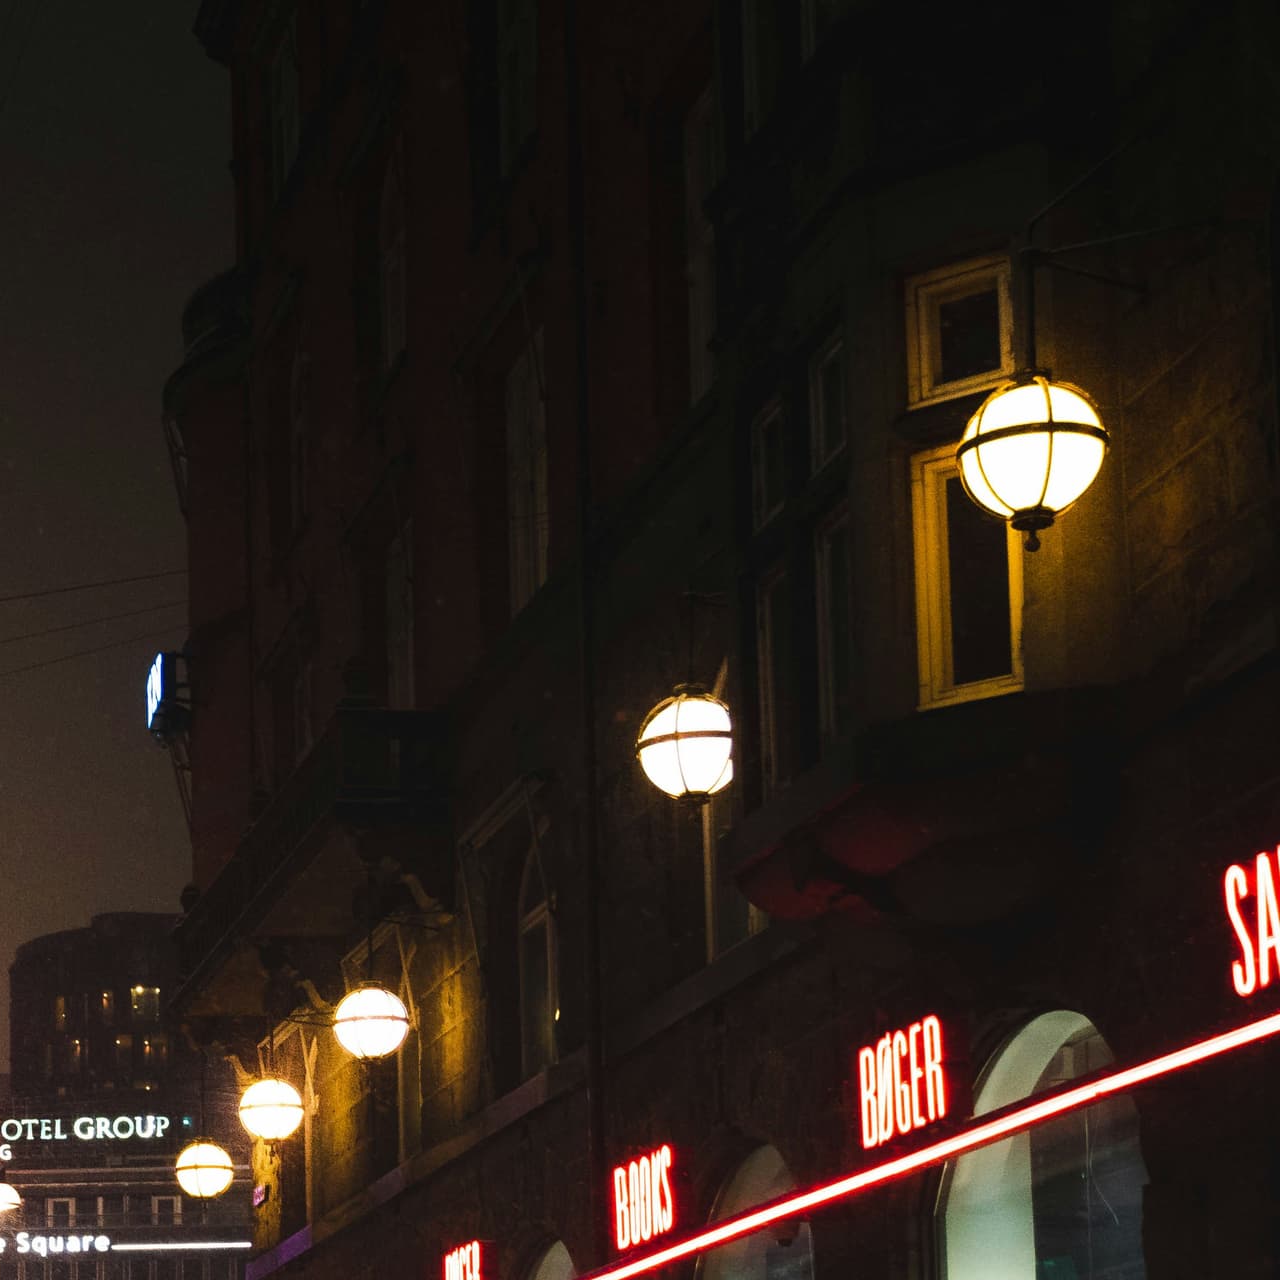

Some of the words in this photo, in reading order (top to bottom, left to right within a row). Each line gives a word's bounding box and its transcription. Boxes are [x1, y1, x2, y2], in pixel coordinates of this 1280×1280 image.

[1224, 845, 1280, 997] SA
[73, 1115, 170, 1140] GROUP
[858, 1015, 946, 1149] BØGER
[16, 1231, 110, 1258] Square
[614, 1145, 673, 1250] BOOKS
